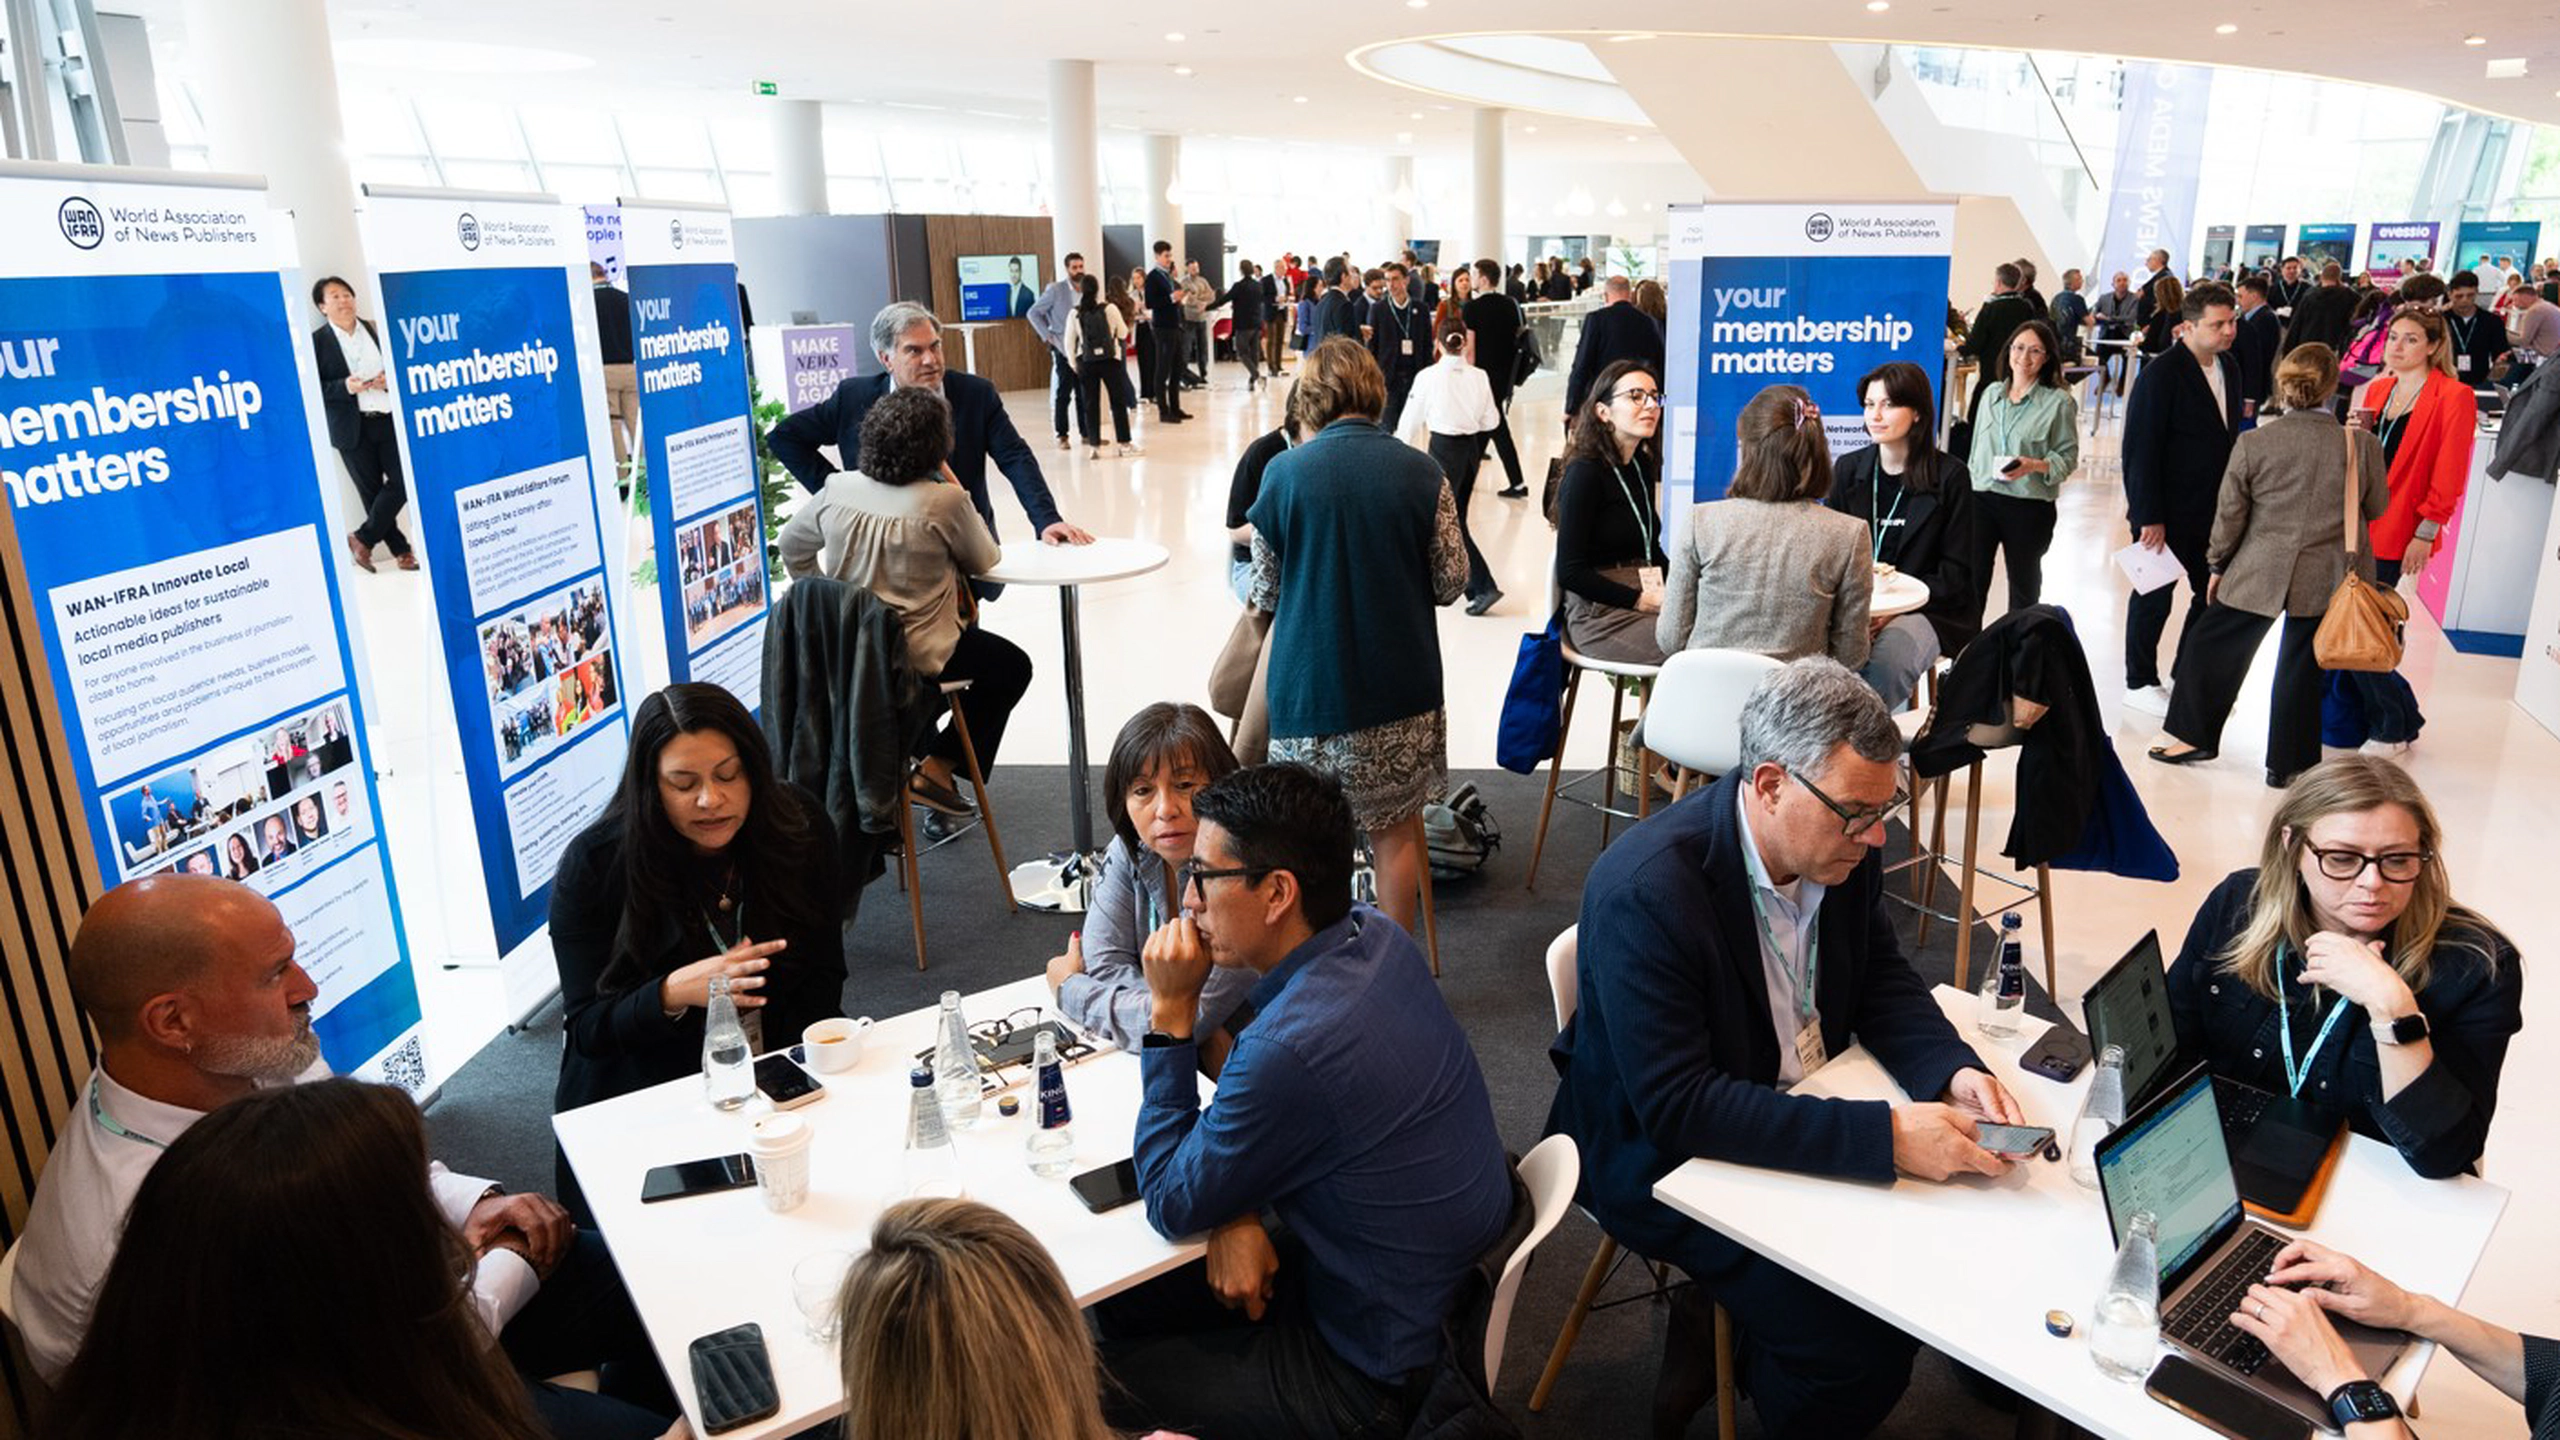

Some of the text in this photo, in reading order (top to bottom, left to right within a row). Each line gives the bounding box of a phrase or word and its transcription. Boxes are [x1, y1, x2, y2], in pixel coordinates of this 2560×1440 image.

[109, 207, 246, 224] World Association
[1839, 218, 1936, 227] World Association
[2378, 226, 2430, 239] evessio
[114, 227, 257, 242] of News Publishers
[1839, 229, 1940, 238] of News Publishers
[636, 297, 671, 332] your
[1714, 287, 1786, 317] your
[397, 312, 460, 359] your
[640, 319, 730, 360] membership
[791, 336, 839, 355] MAKE
[1712, 313, 1913, 350] membership
[0, 338, 60, 379] ur
[406, 338, 558, 395] membership
[795, 353, 839, 371] NEWS
[1711, 348, 1834, 374] matters
[643, 361, 702, 393] matters
[795, 368, 848, 387] GREAT
[0, 370, 263, 449] embership
[414, 392, 513, 438] matters
[66, 557, 250, 618] WAN-IFRA Innovate Local
[72, 577, 270, 644] Actionable ideas for sustainable
[77, 611, 223, 667] local media publishers
[84, 676, 100, 689] For
[100, 665, 139, 686] anyone
[138, 650, 180, 672] involved
[188, 643, 203, 655] the
[204, 630, 243, 650] business
[88, 687, 115, 704] close
[115, 684, 127, 695] to
[94, 704, 137, 729] Focusing
[137, 701, 151, 712] on
[152, 690, 178, 706] local
[178, 676, 216, 697] audience
[247, 653, 280, 672] business
[97, 711, 161, 743] opportunities
[161, 703, 182, 718] and
[183, 688, 222, 711] problems
[222, 677, 253, 697] unique
[262, 669, 275, 680] the
[101, 744, 112, 756] of
[112, 735, 136, 752] local
